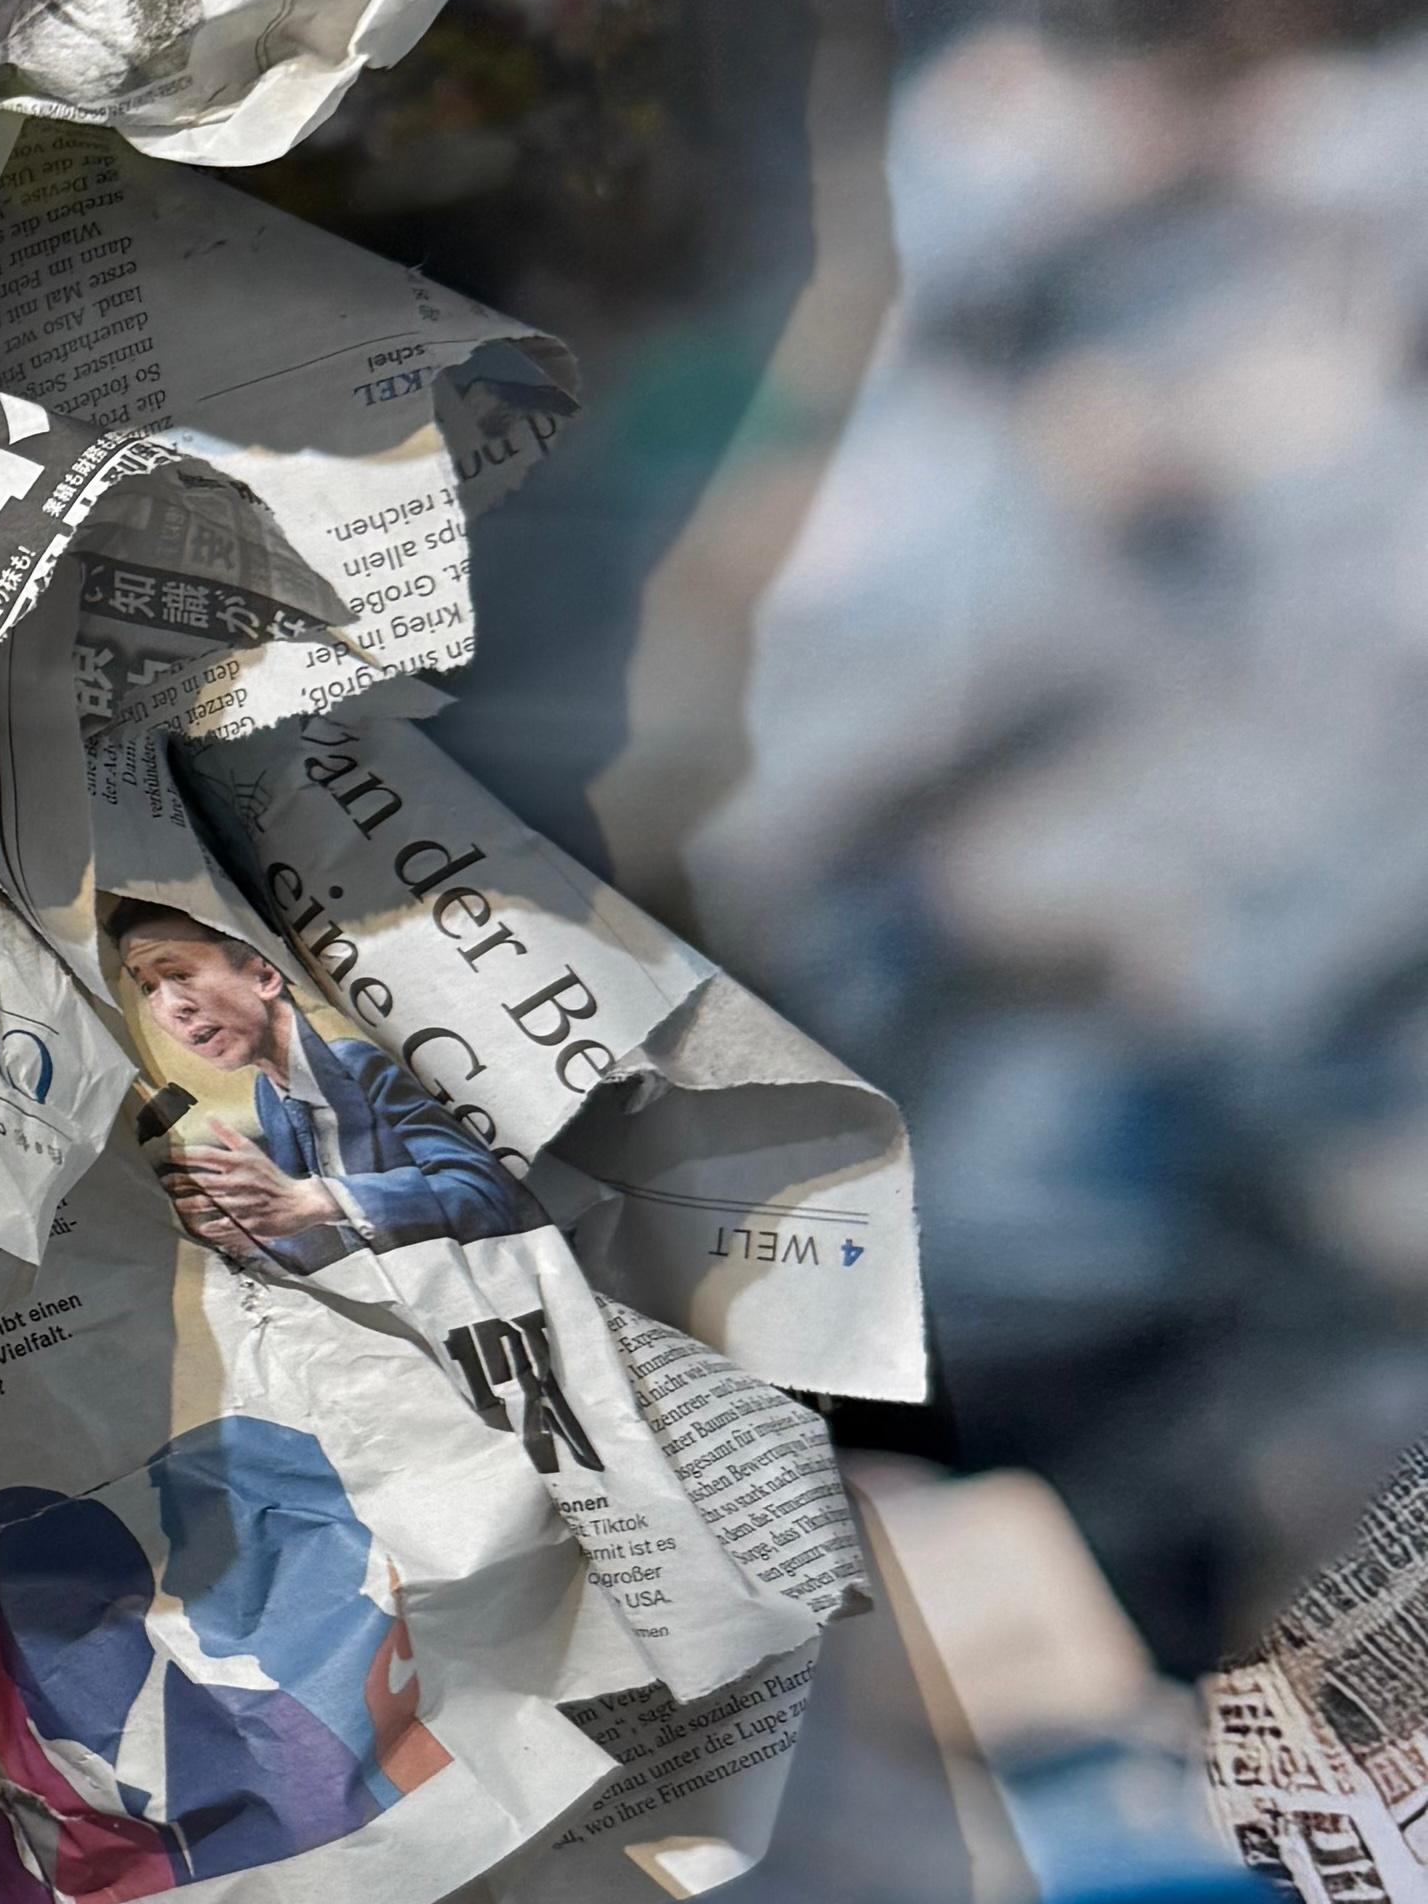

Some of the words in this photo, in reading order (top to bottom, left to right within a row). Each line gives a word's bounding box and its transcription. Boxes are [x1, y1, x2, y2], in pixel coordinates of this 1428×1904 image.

[253, 862, 394, 1031] eine
[392, 840, 527, 972] der
[502, 964, 637, 1095] Be
[708, 1227, 820, 1266] WELT
[839, 1237, 866, 1268] 4
[27, 1293, 84, 1323] einen
[587, 1512, 650, 1537] Tiktok
[627, 1538, 655, 1558] ist
[654, 1536, 678, 1553] es
[623, 1588, 673, 1610] USA.
